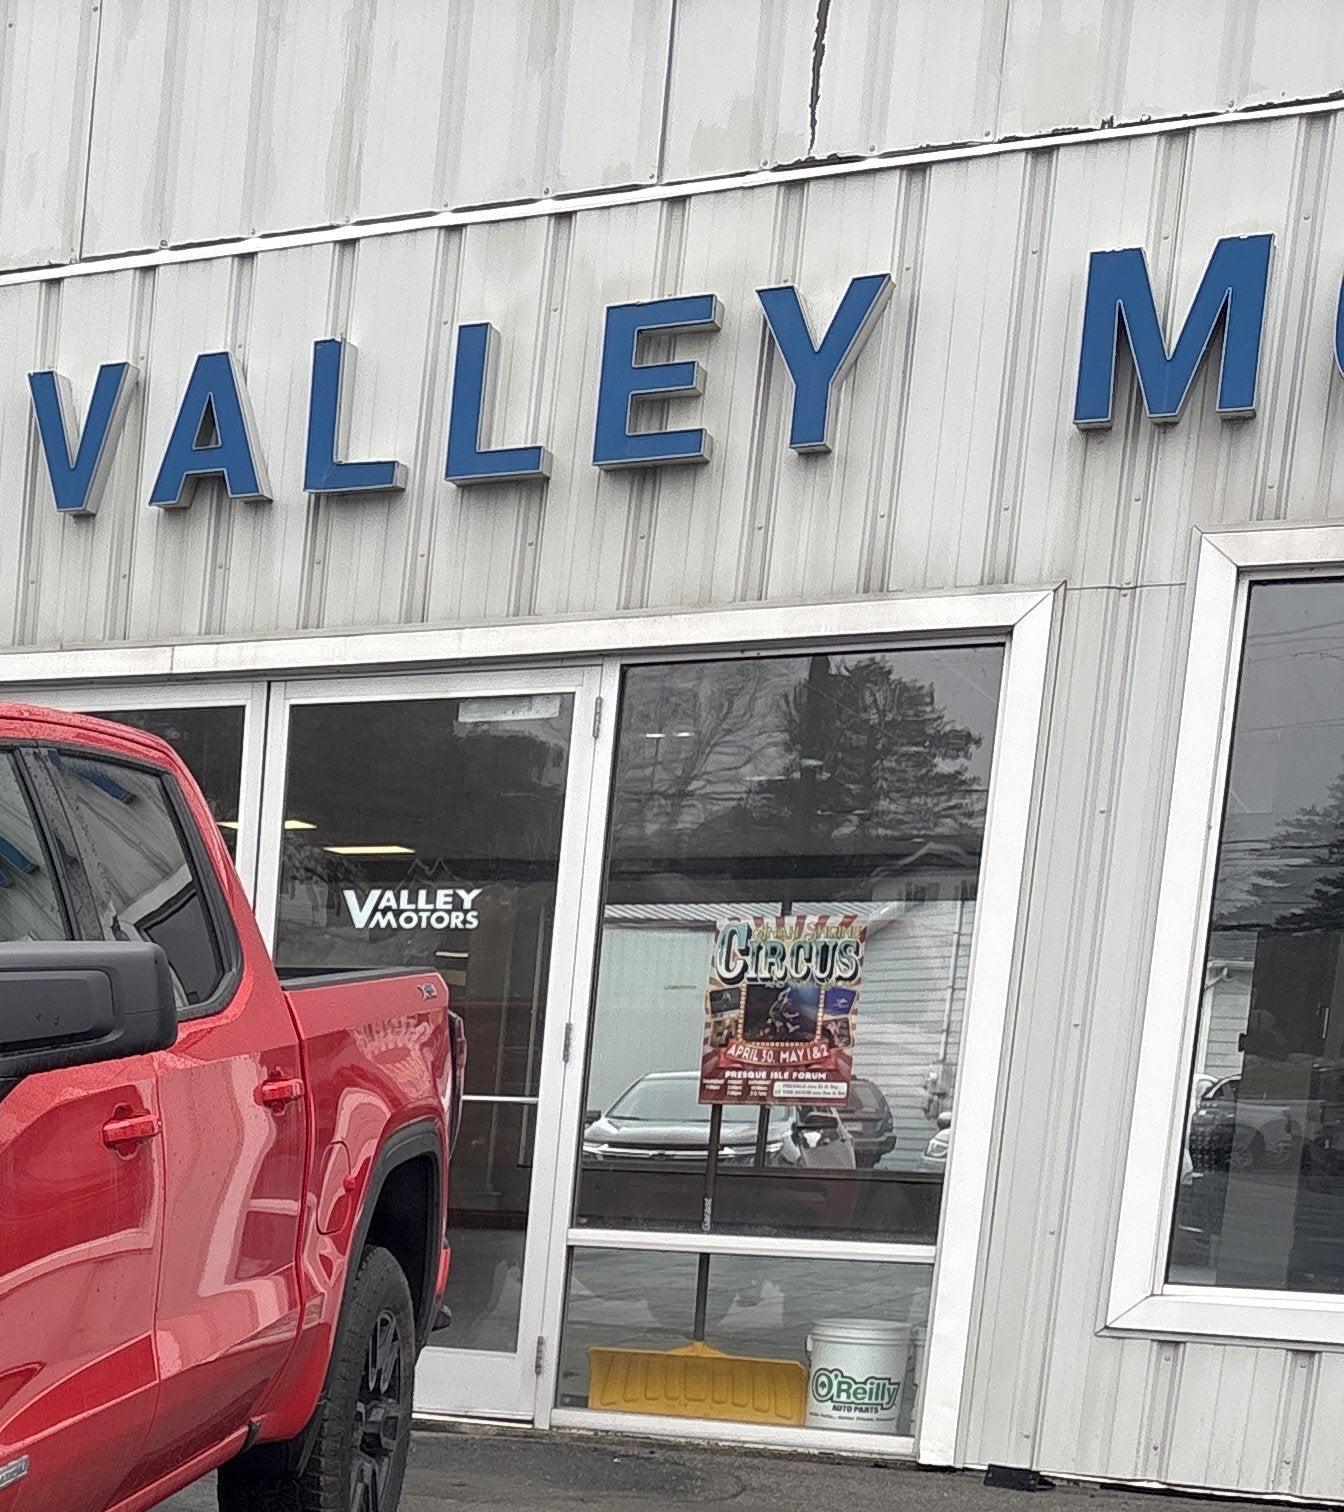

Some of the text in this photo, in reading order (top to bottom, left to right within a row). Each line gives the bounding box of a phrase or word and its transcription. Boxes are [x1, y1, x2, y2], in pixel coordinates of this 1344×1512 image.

[27, 232, 1344, 516] VALLEY M
[342, 888, 483, 929] VALLEY
[368, 910, 480, 930] MOTORS
[715, 922, 862, 985] CIRCUS
[727, 1044, 759, 1062] APRIL
[779, 1048, 804, 1064] MAY
[724, 1070, 767, 1079] PRESQUE
[792, 1071, 827, 1080] FORUM
[814, 1371, 898, 1408] O'Reilly
[831, 1405, 879, 1414] AUTO PARTS
